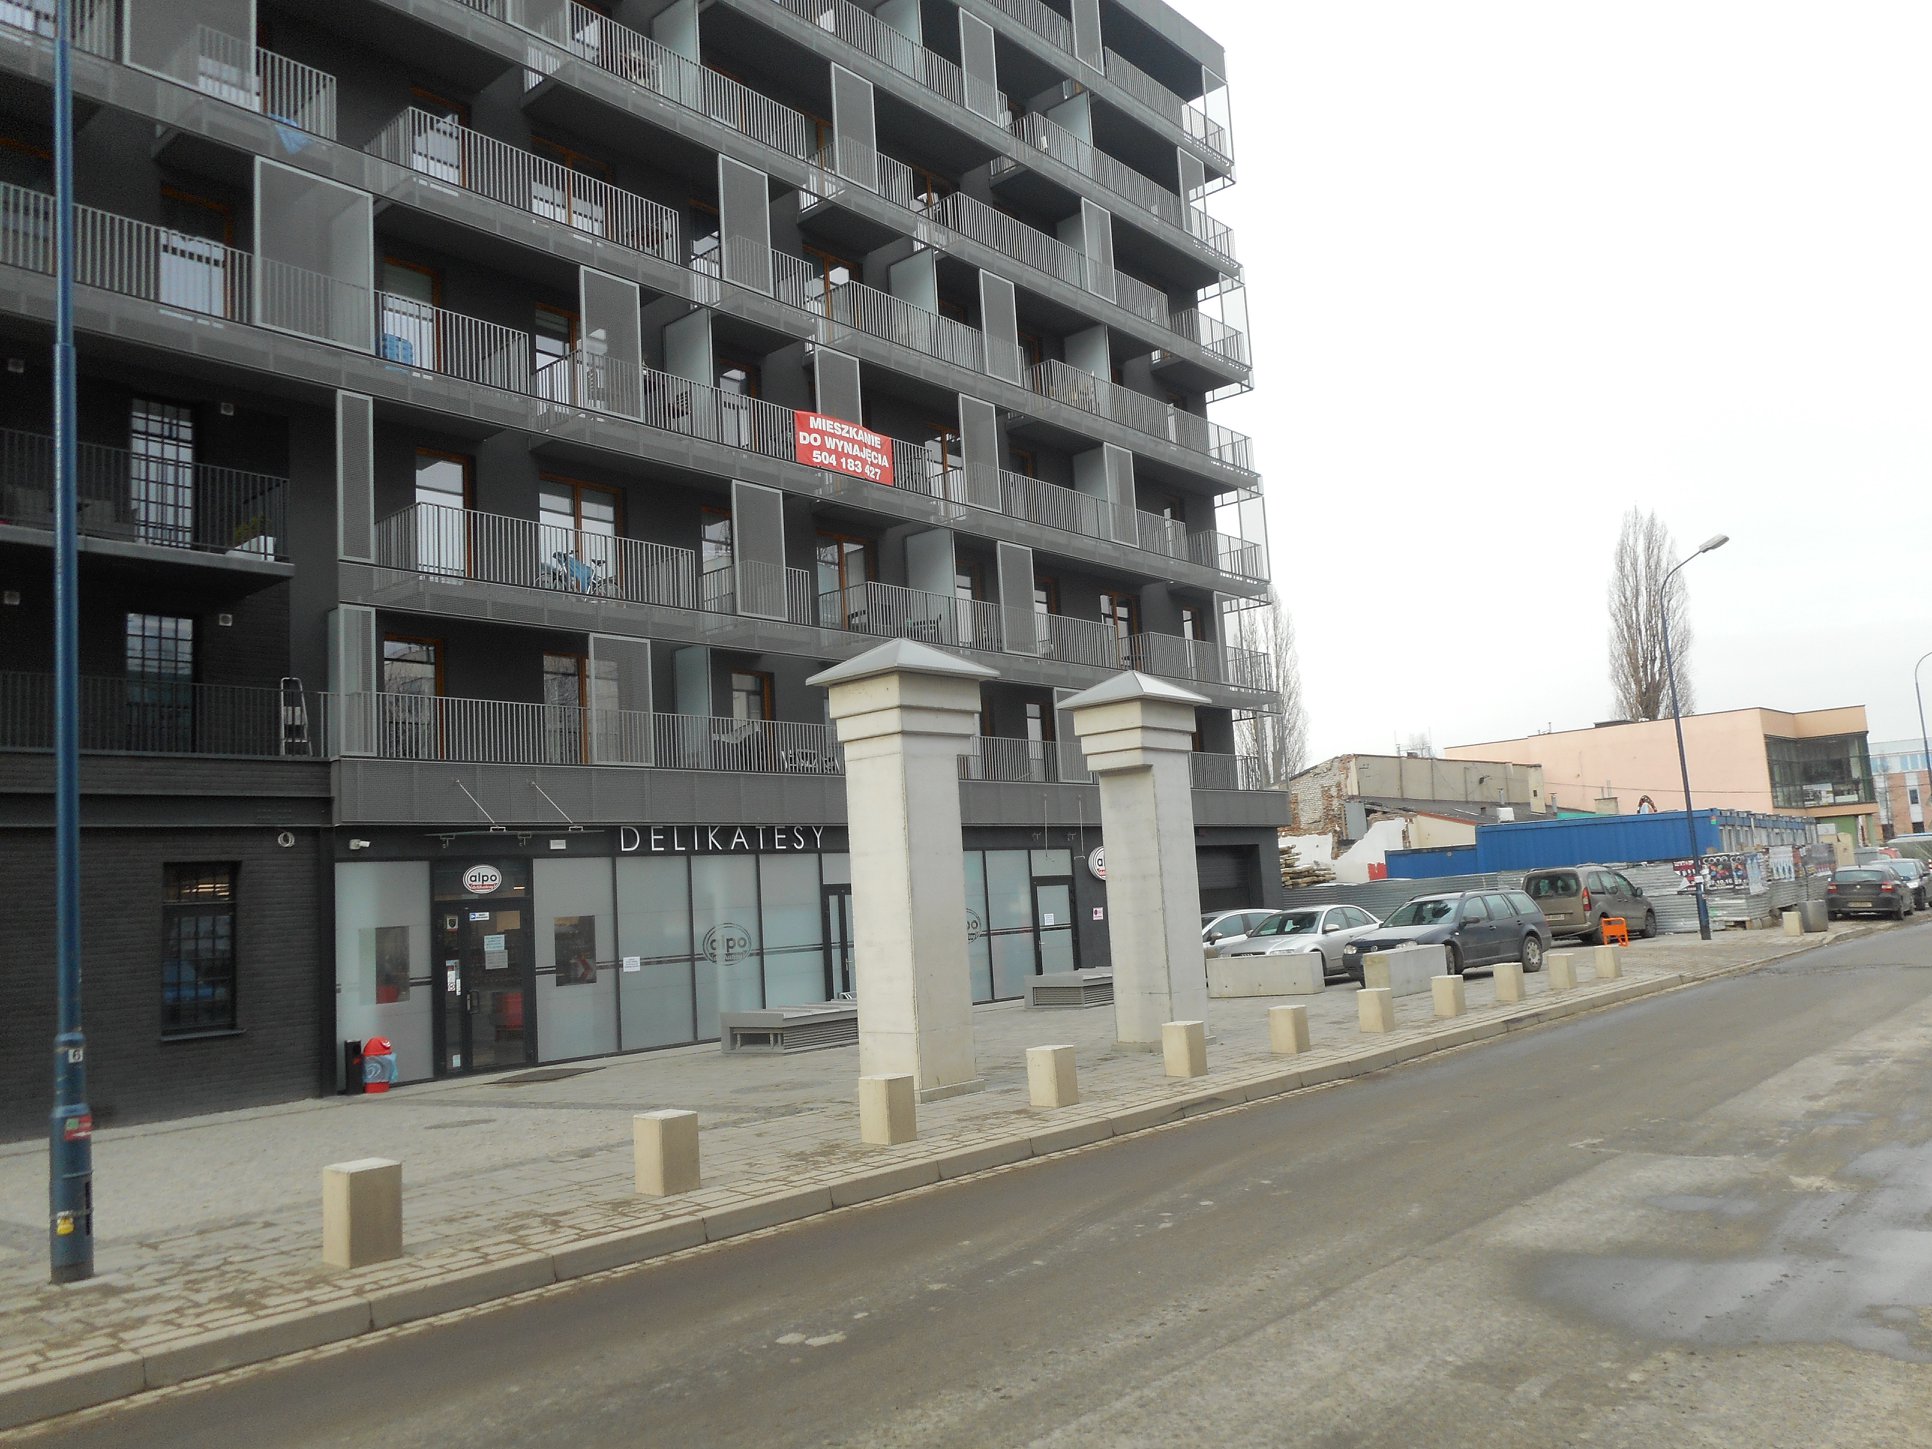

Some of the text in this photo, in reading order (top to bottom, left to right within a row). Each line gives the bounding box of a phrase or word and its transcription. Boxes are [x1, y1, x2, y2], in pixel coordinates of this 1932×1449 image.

[809, 416, 881, 449] MIESZKANIE
[799, 431, 890, 468] DO WYNAJĘCIA
[812, 450, 881, 481] 504 183 427
[620, 826, 824, 852] DELIKATESY
[469, 871, 498, 885] alpo
